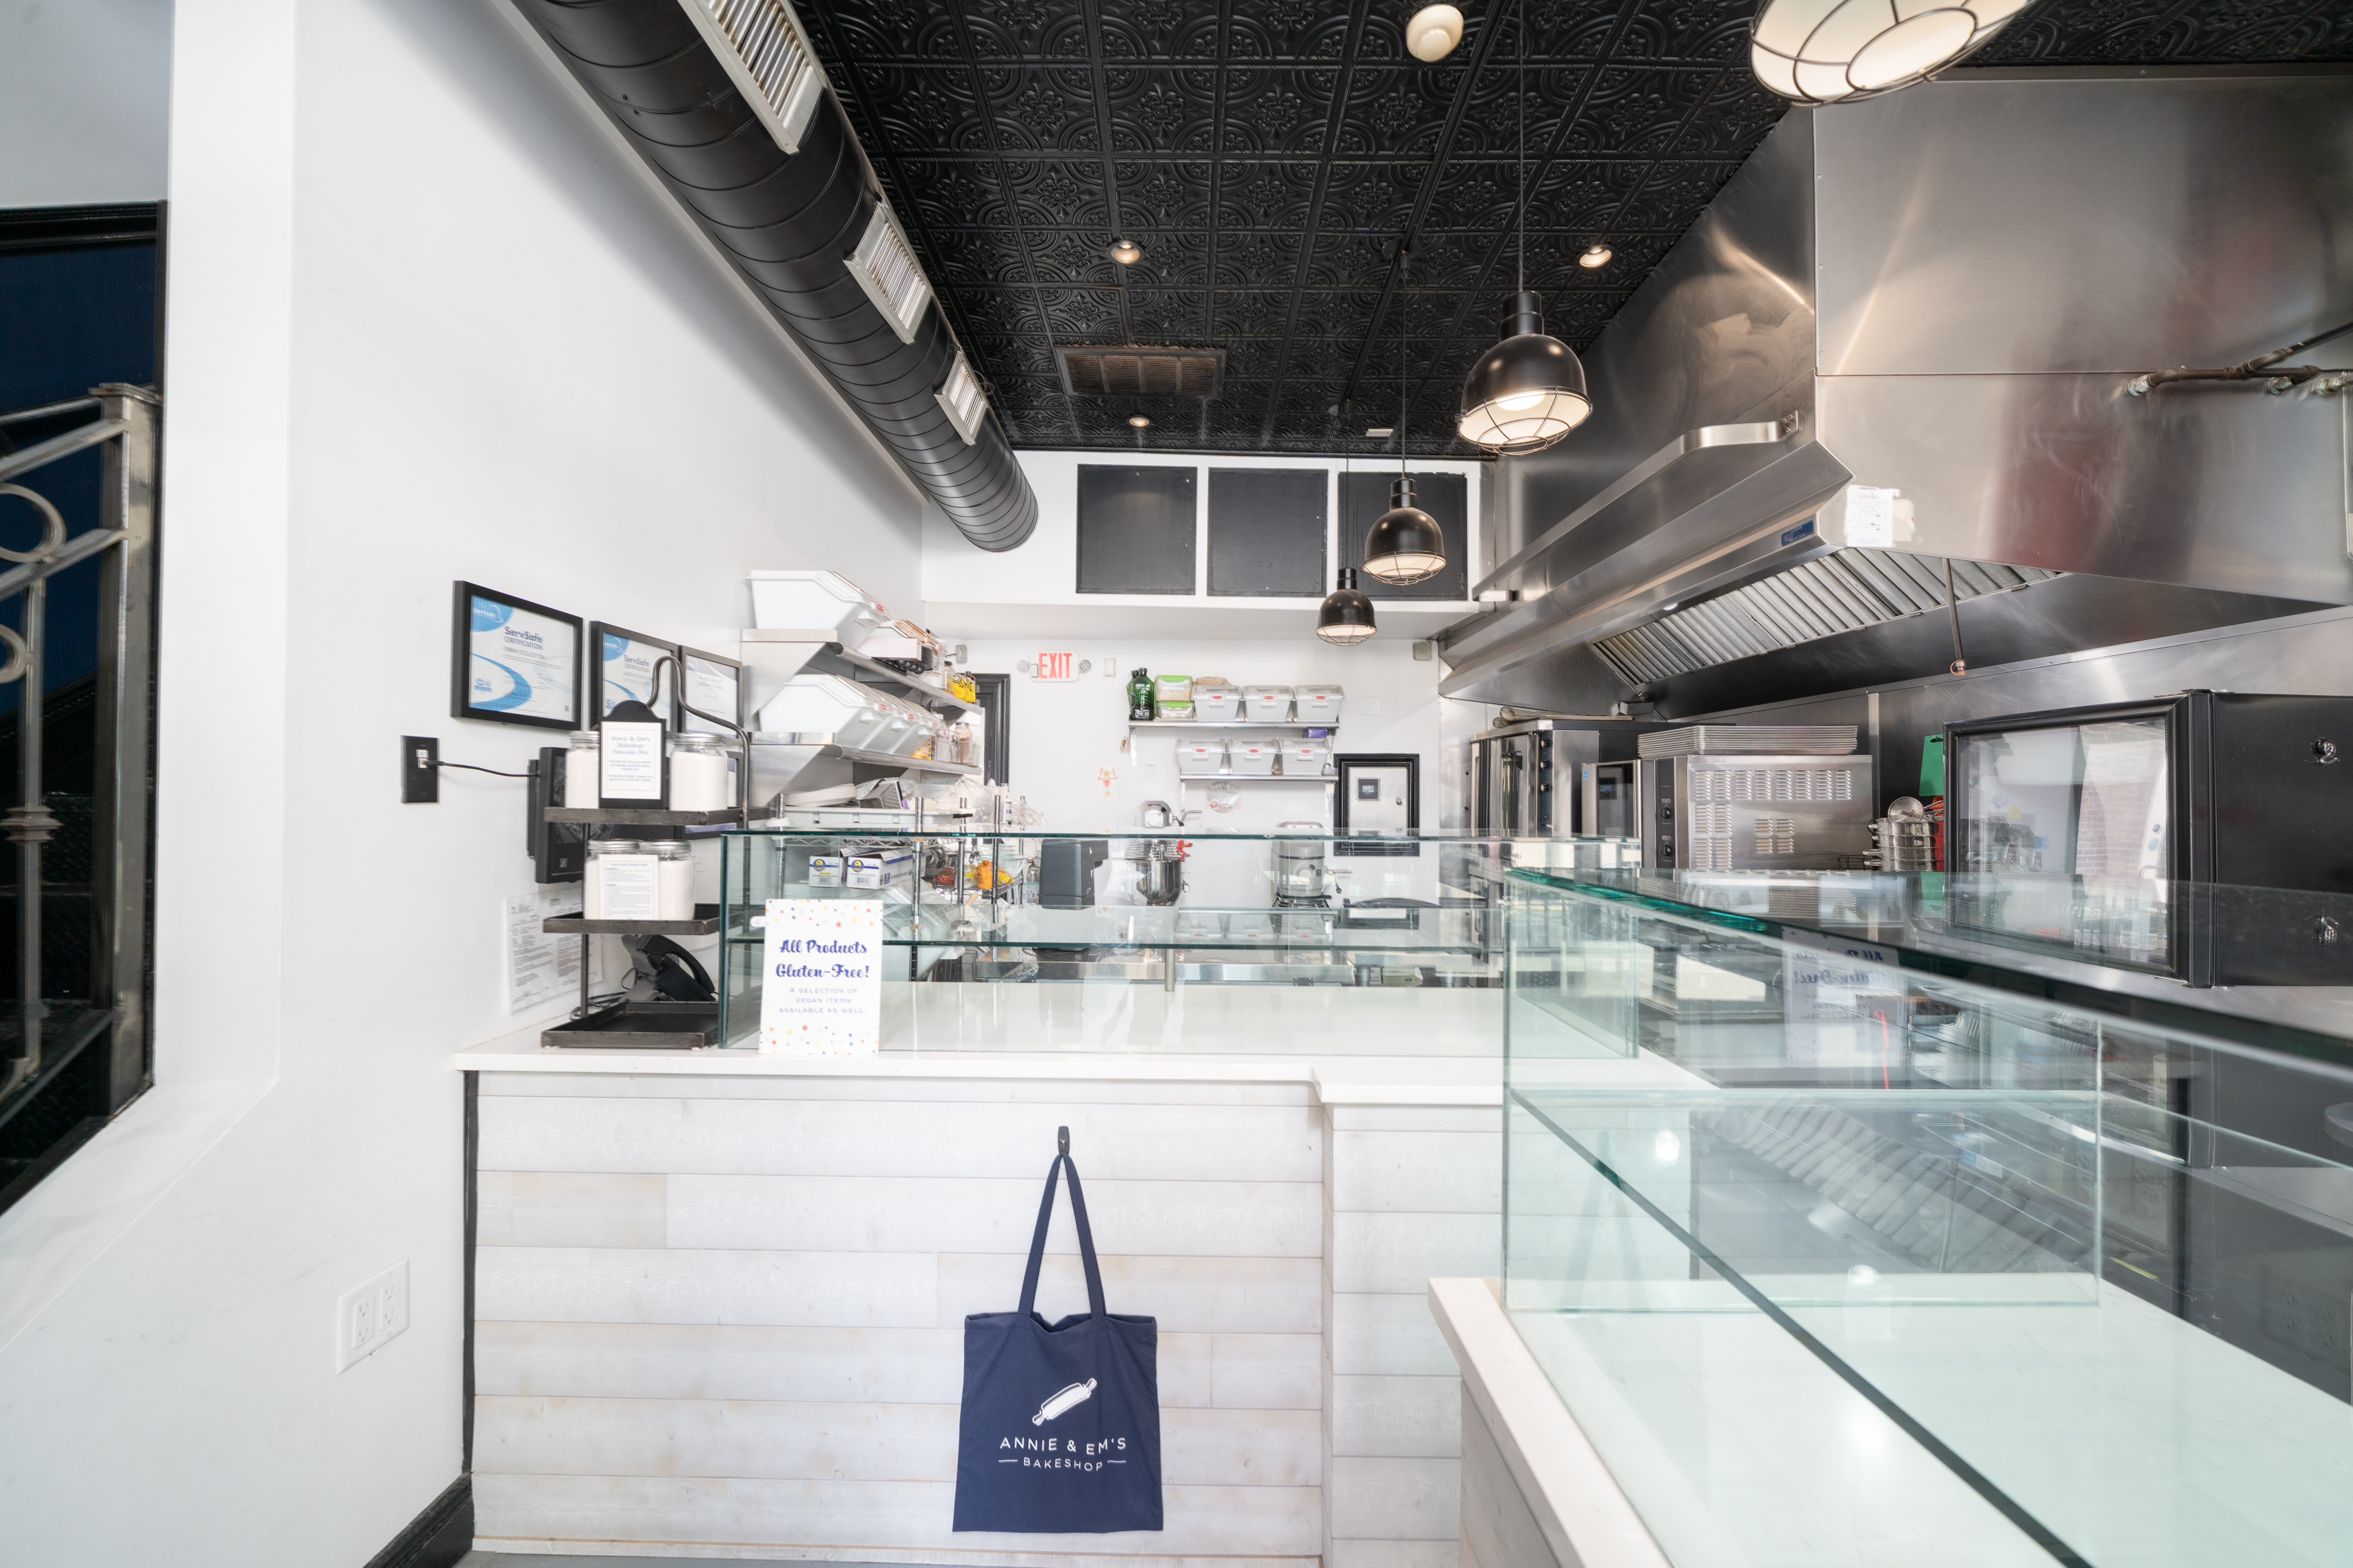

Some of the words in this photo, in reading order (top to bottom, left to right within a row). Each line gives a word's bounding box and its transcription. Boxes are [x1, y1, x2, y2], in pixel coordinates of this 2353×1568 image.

[504, 626, 544, 643] ServSafe
[504, 636, 544, 651] CERTIFICATION
[623, 654, 650, 668] ServSafe
[623, 663, 650, 674] CERTIFICATION
[1039, 652, 1072, 679] EXIT
[779, 939, 803, 953] All
[805, 939, 867, 954] Products
[775, 963, 870, 978] Gluten-Free!
[1000, 1437, 1057, 1452] ANNIE
[1067, 1439, 1076, 1453] &
[1086, 1437, 1126, 1455] EM'S
[1023, 1457, 1103, 1471] BAKESHOP
